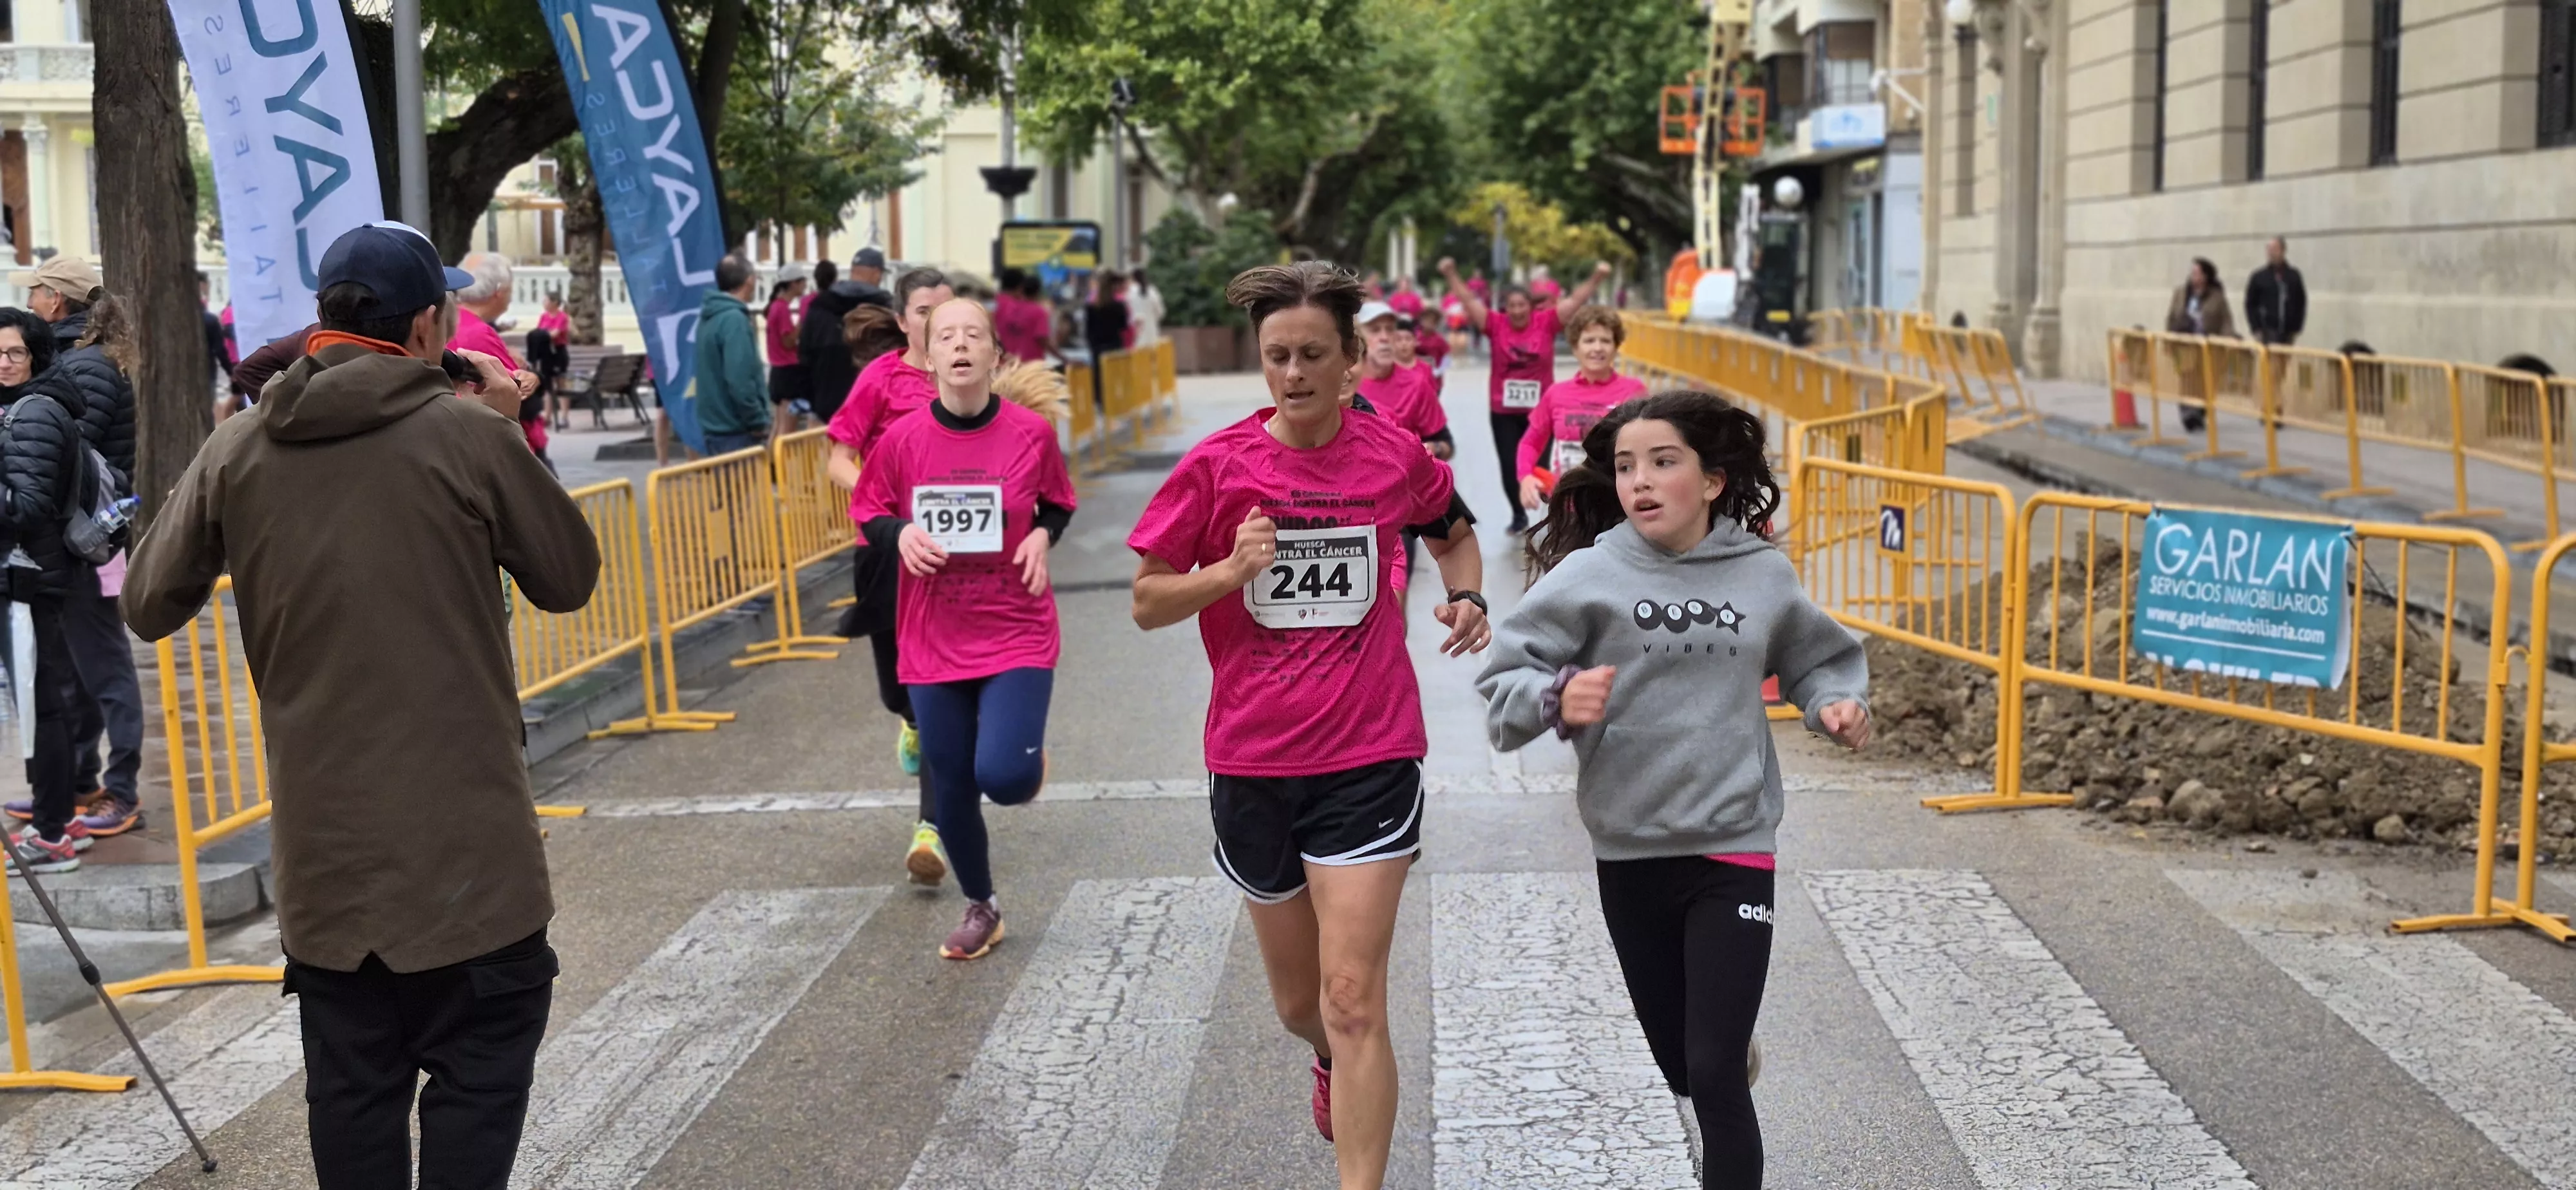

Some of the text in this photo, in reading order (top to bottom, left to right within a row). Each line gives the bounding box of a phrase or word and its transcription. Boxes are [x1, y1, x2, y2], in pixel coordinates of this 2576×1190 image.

[922, 509, 992, 533] 1997
[1274, 545, 1363, 560] NTRA EL CÁNCER
[1294, 540, 1326, 549] HUESCA
[2154, 522, 2335, 592] GARLAN
[1270, 562, 1352, 600] 244
[2149, 575, 2329, 616] SERVICIOS INMOBILIARIOS
[2146, 607, 2325, 645] www.garlaninmobiliaria.com
